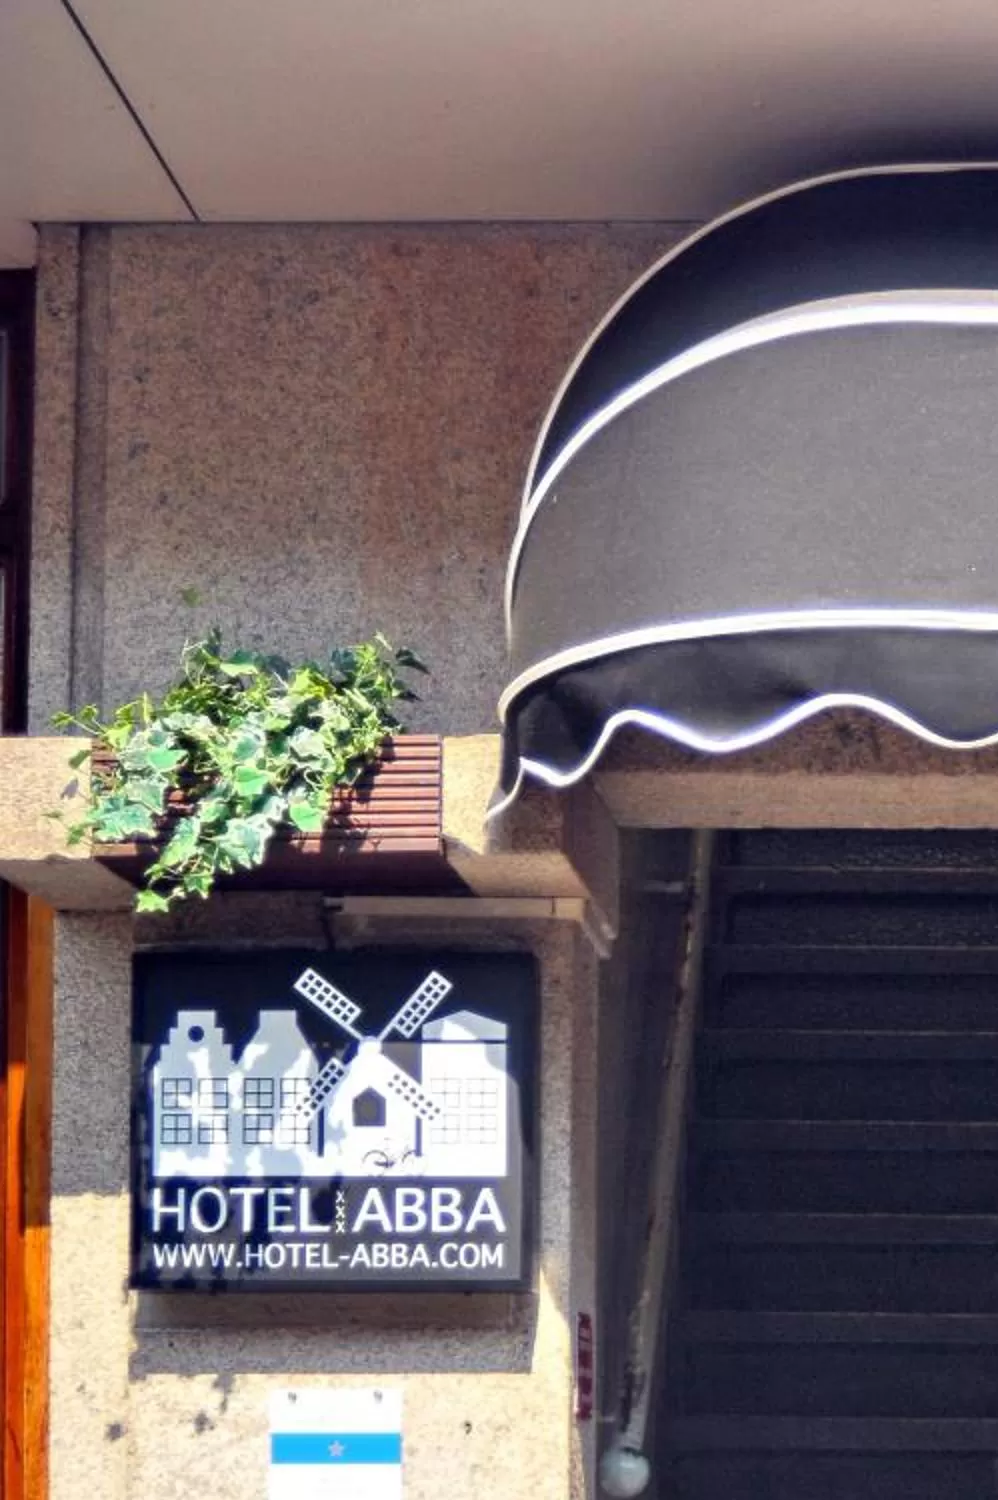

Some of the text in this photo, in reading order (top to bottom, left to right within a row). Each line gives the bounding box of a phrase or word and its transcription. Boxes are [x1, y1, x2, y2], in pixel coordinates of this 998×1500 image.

[152, 1187, 331, 1233] HOTEL
[352, 1187, 507, 1233] ABBA
[152, 1243, 503, 1269] WWW.HOTEL-ABBA.COM
